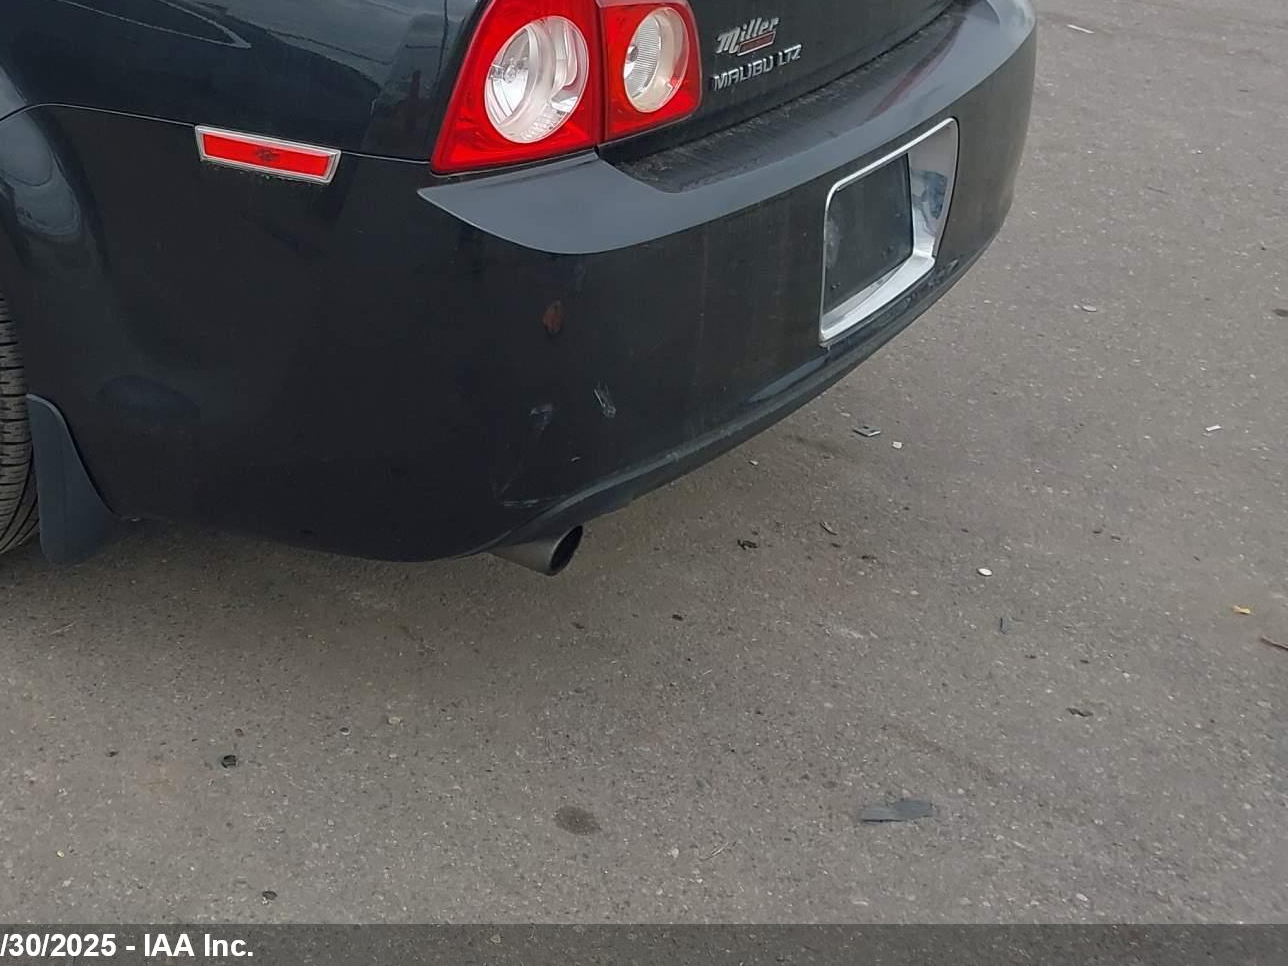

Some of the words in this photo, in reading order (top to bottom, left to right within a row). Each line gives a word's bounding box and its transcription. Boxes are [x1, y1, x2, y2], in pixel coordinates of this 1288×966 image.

[716, 17, 779, 54] Miller
[714, 55, 774, 90] MALIBU
[779, 44, 802, 65] LTZ
